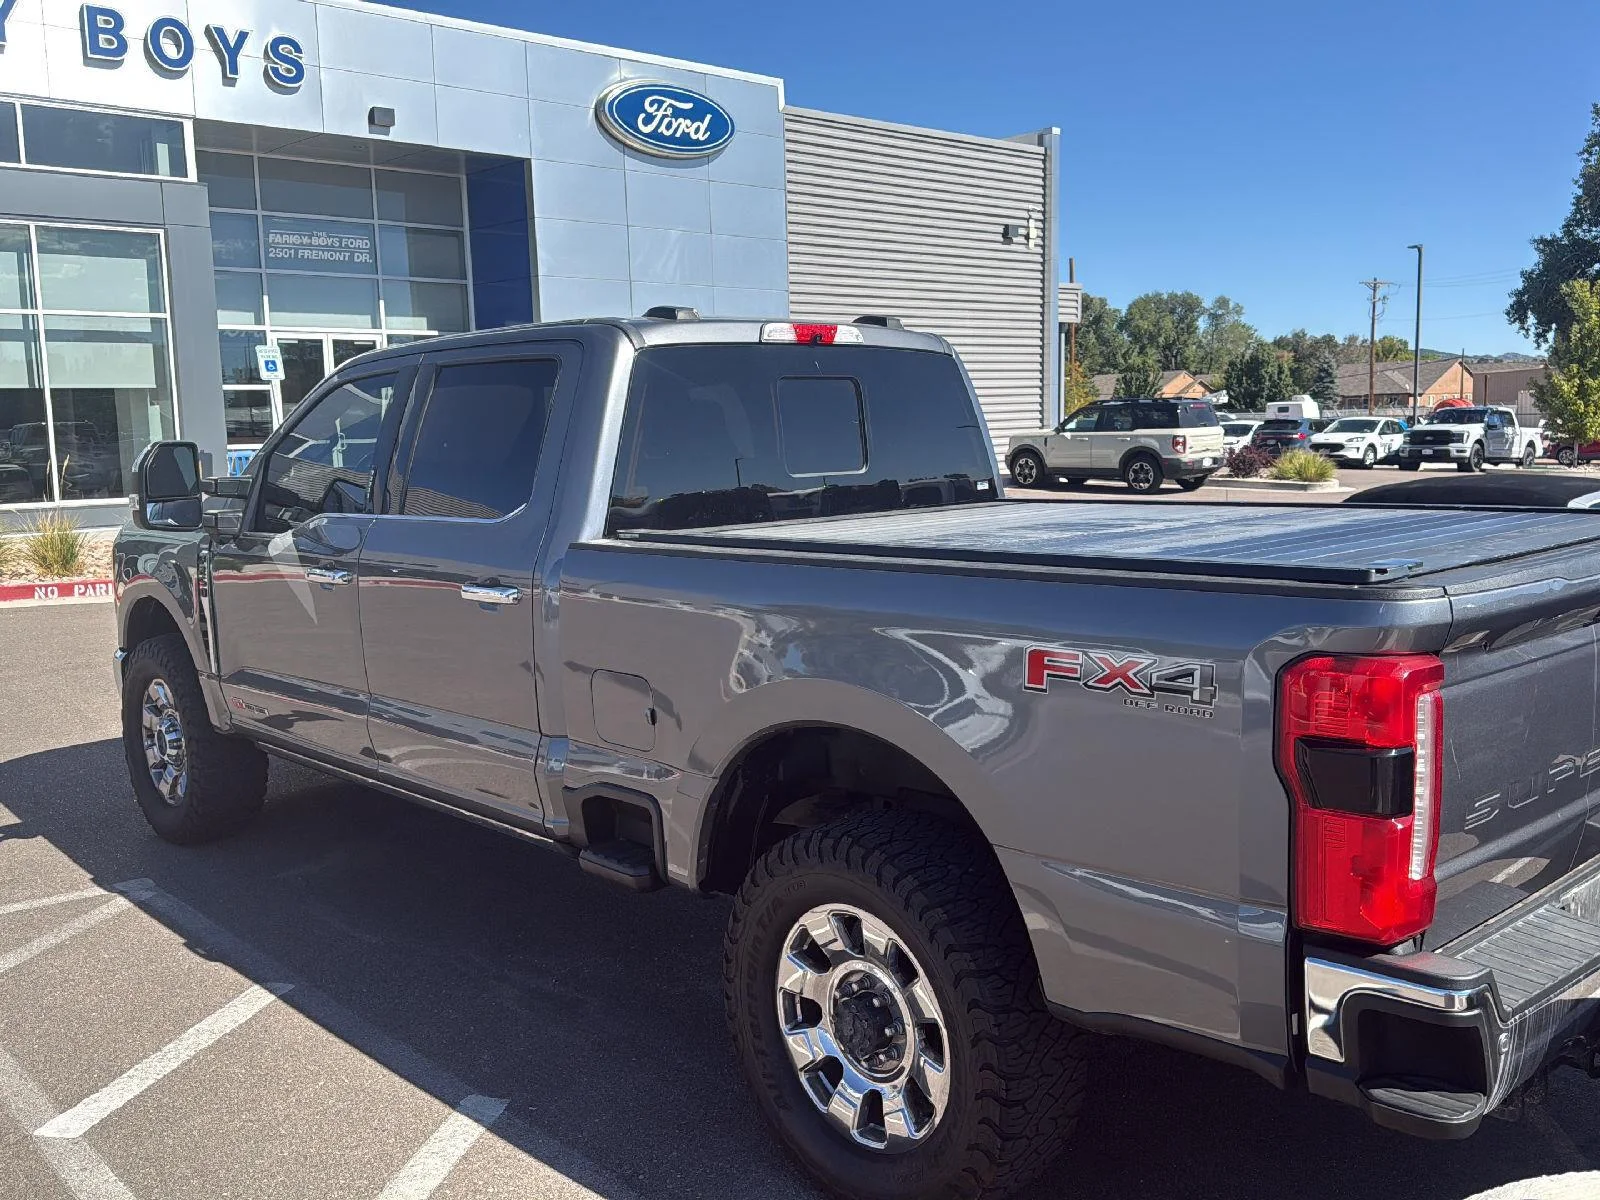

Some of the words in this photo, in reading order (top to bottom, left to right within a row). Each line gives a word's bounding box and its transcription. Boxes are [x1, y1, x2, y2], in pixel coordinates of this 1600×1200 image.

[80, 3, 305, 90] BOYS
[637, 95, 713, 141] Ford
[311, 236, 340, 248] BOYS
[342, 239, 371, 249] FORD
[268, 247, 296, 259] 2501
[298, 249, 351, 261] FREMONT
[353, 252, 373, 263] DR.
[34, 586, 59, 600] NO
[1023, 643, 1219, 708] FX4
[1122, 697, 1159, 711] OFF
[1163, 703, 1216, 719] ROAD
